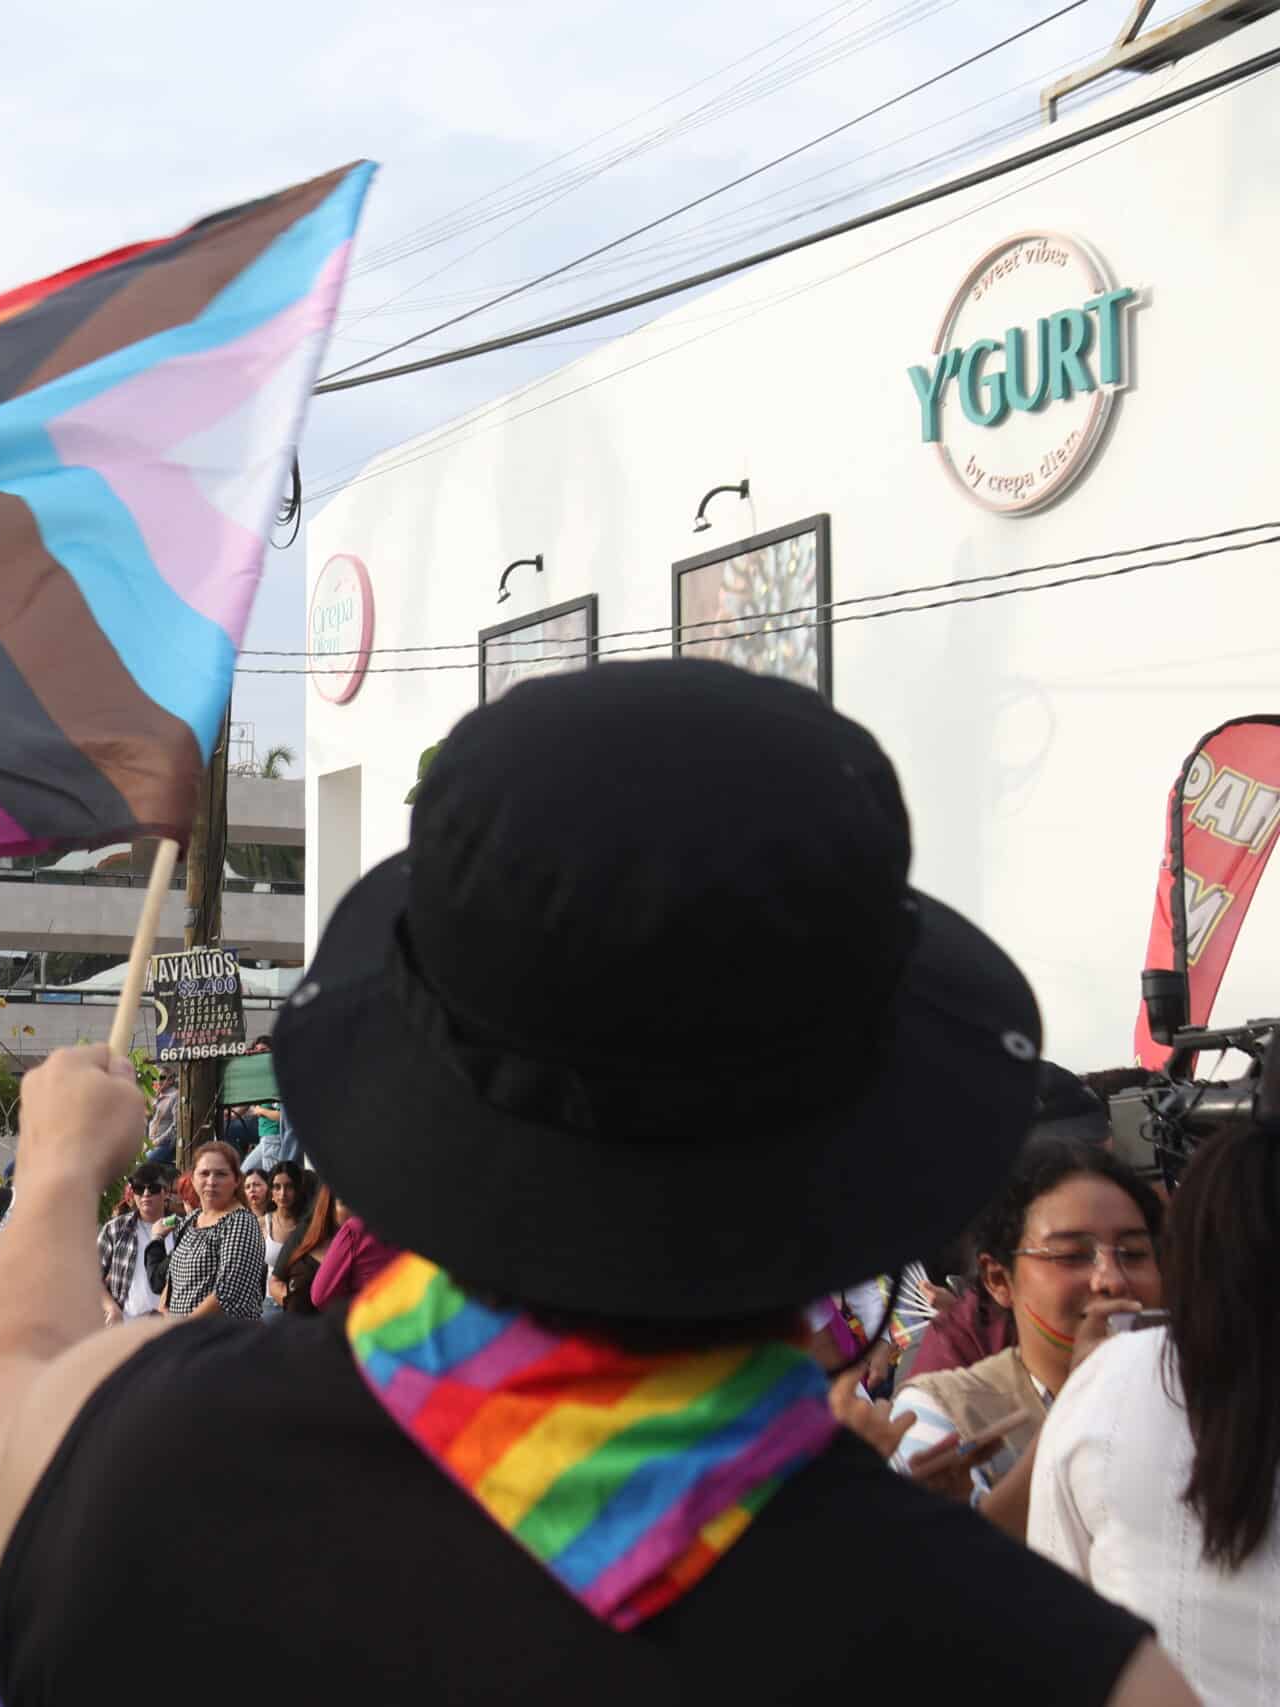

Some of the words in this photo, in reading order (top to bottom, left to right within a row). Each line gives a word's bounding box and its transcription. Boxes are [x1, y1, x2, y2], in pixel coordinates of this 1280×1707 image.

[973, 244, 1023, 301] sweet
[1025, 239, 1069, 268] vibes
[966, 454, 986, 489] by
[988, 472, 1034, 499] crepa
[177, 976, 237, 997] $2,400
[183, 996, 216, 1007] CASAS
[183, 1004, 229, 1016] LOCALES
[184, 1011, 238, 1025] TERRENOS
[160, 1041, 246, 1062] 6671966449
